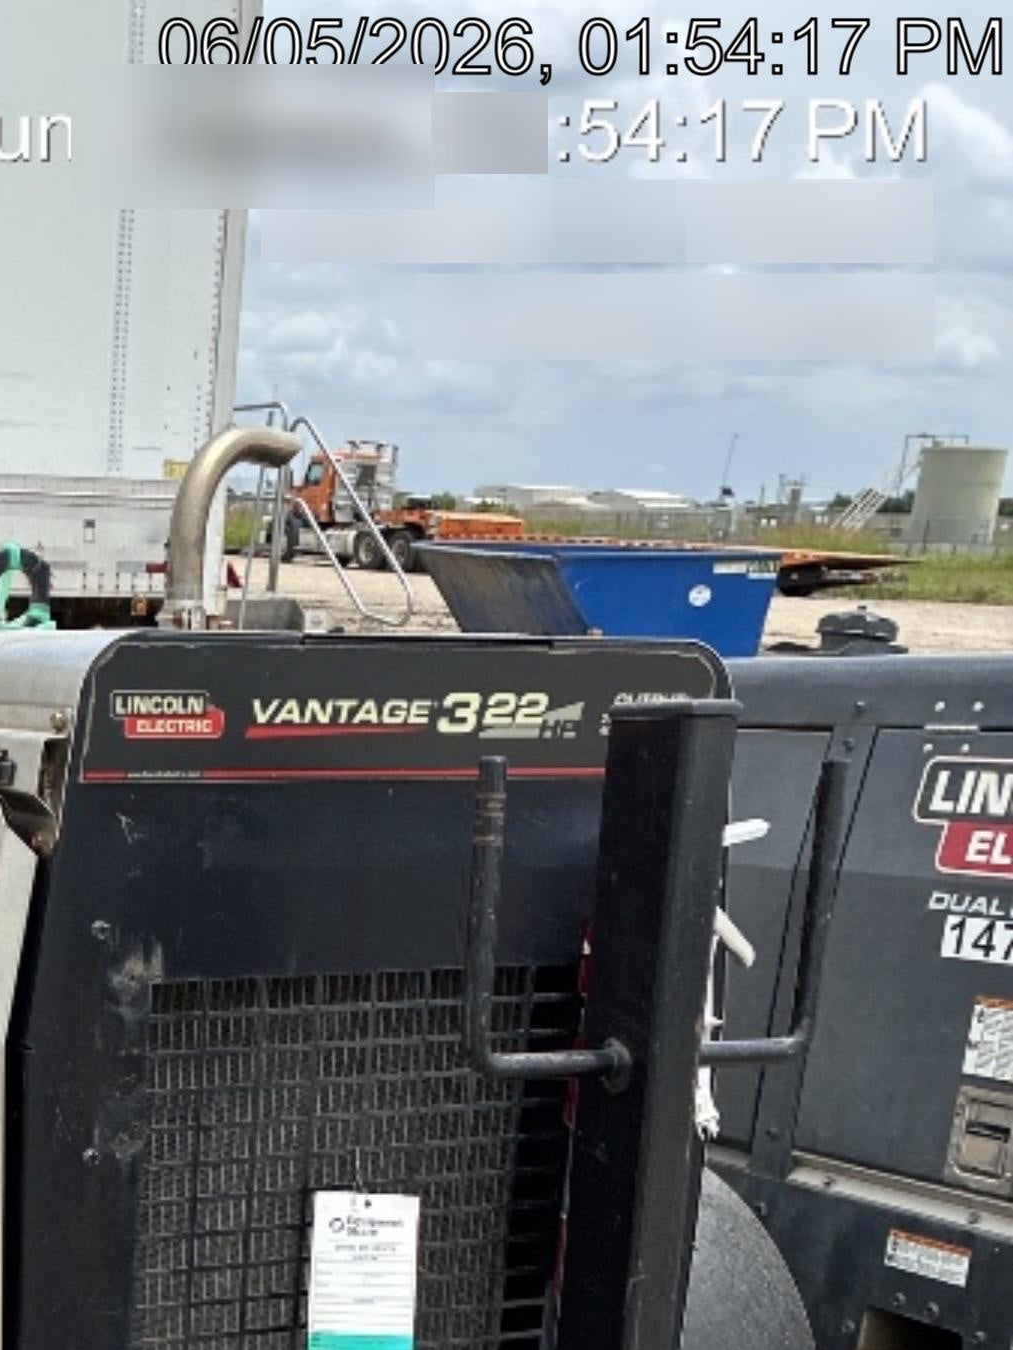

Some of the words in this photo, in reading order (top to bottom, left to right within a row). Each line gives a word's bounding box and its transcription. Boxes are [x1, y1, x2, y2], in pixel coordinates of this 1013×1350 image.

[114, 695, 205, 715] LINCOLN
[252, 699, 434, 724] VANTAGE
[437, 691, 550, 734] 322
[135, 719, 213, 733] ELECTRIC
[929, 891, 1006, 916] DUAL
